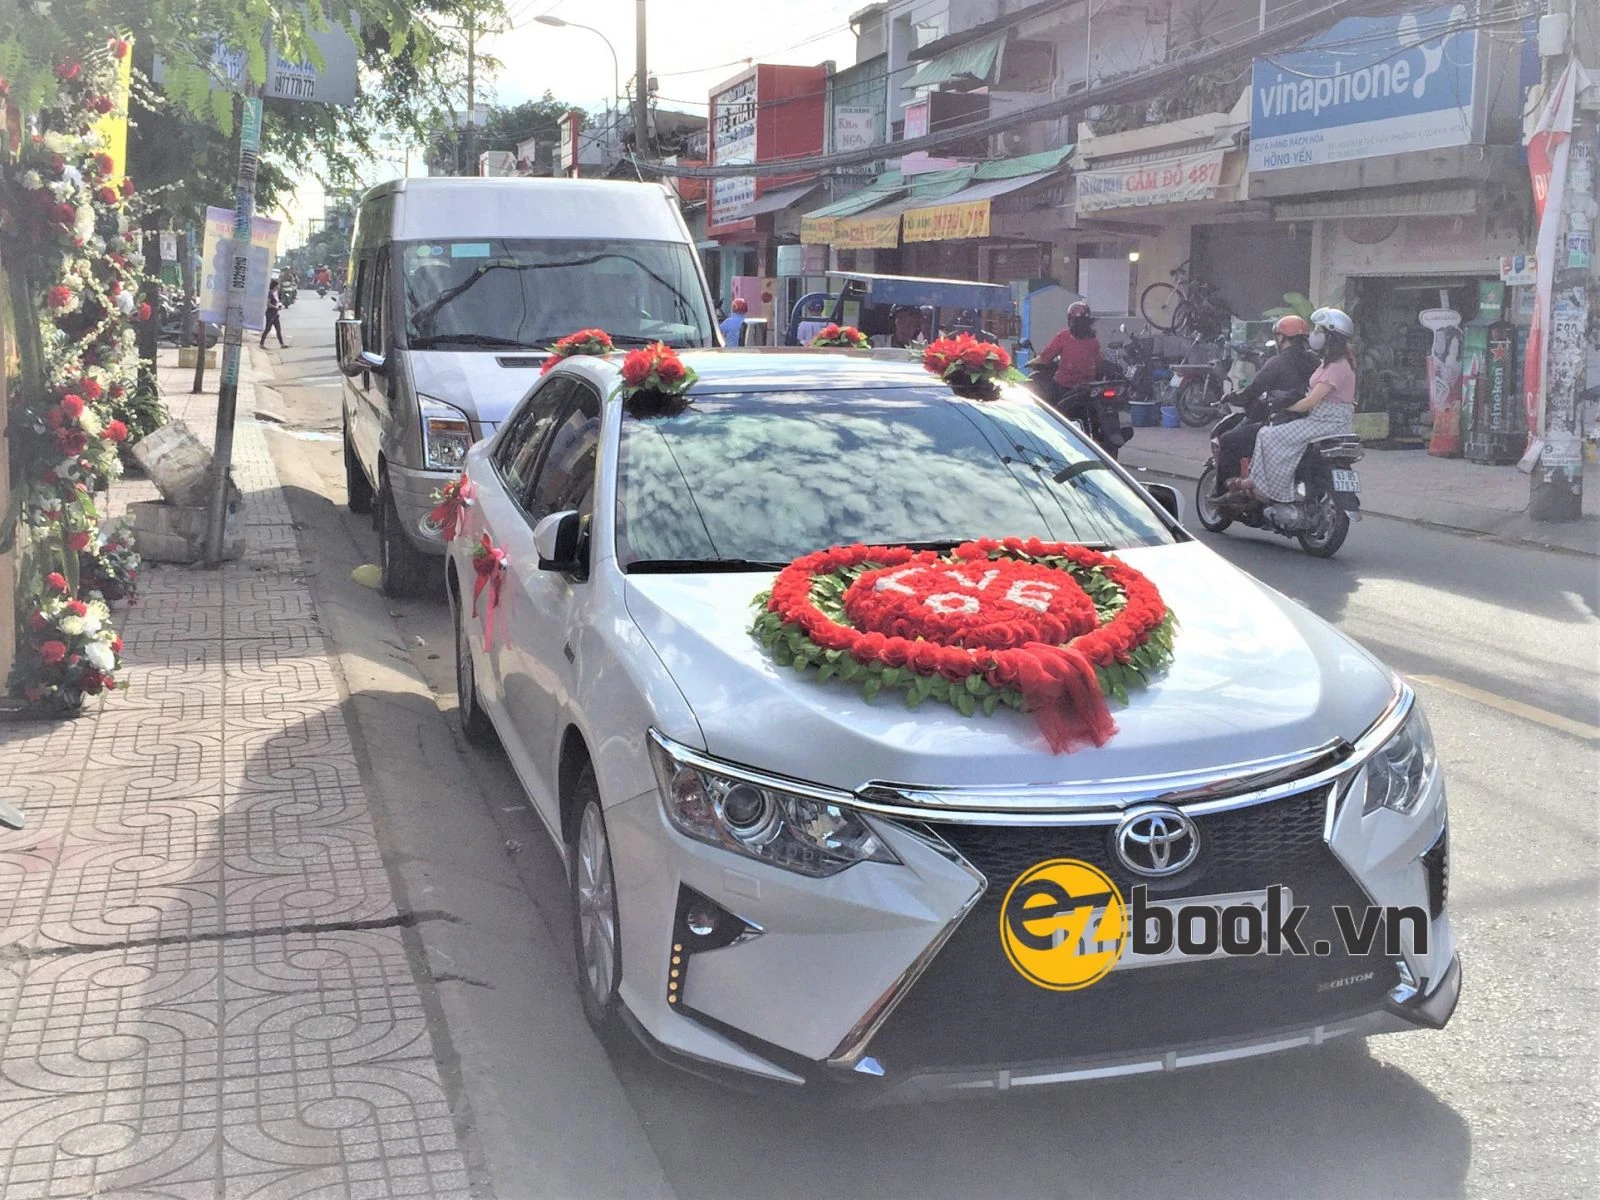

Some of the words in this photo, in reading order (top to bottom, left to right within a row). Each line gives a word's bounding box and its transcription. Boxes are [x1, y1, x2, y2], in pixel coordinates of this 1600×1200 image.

[275, 75, 290, 95] 0977
[1260, 59, 1410, 118] vinaphone
[1126, 165, 1158, 192] CẦM
[1162, 159, 1184, 187] ĐỒ
[1188, 162, 1218, 185] 487
[875, 567, 1060, 613] LOVE
